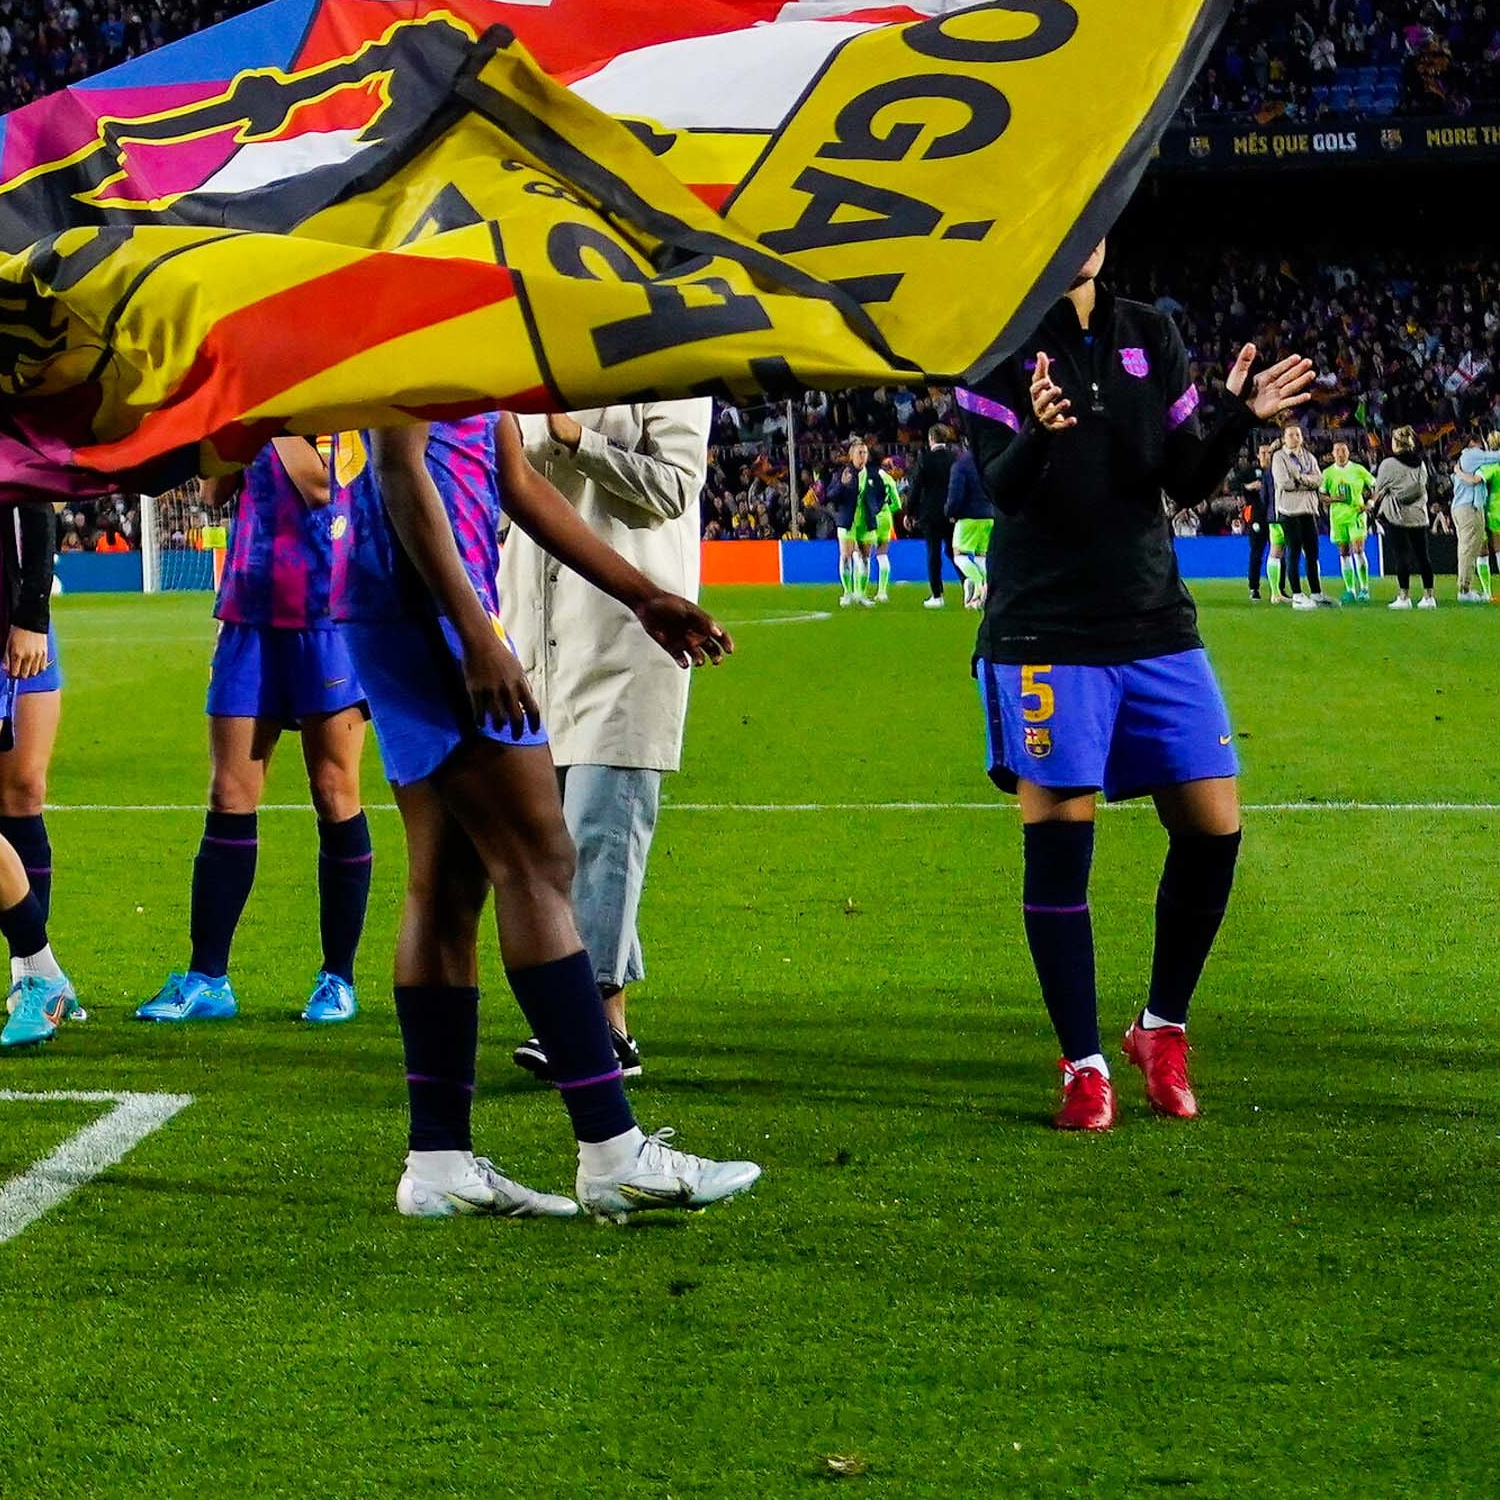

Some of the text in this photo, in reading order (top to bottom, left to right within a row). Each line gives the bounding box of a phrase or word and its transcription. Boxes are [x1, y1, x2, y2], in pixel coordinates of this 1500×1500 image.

[1233, 131, 1268, 157] MÉS
[1272, 132, 1310, 159] QUE
[1426, 127, 1478, 149] MORE
[1021, 664, 1055, 723] 5
